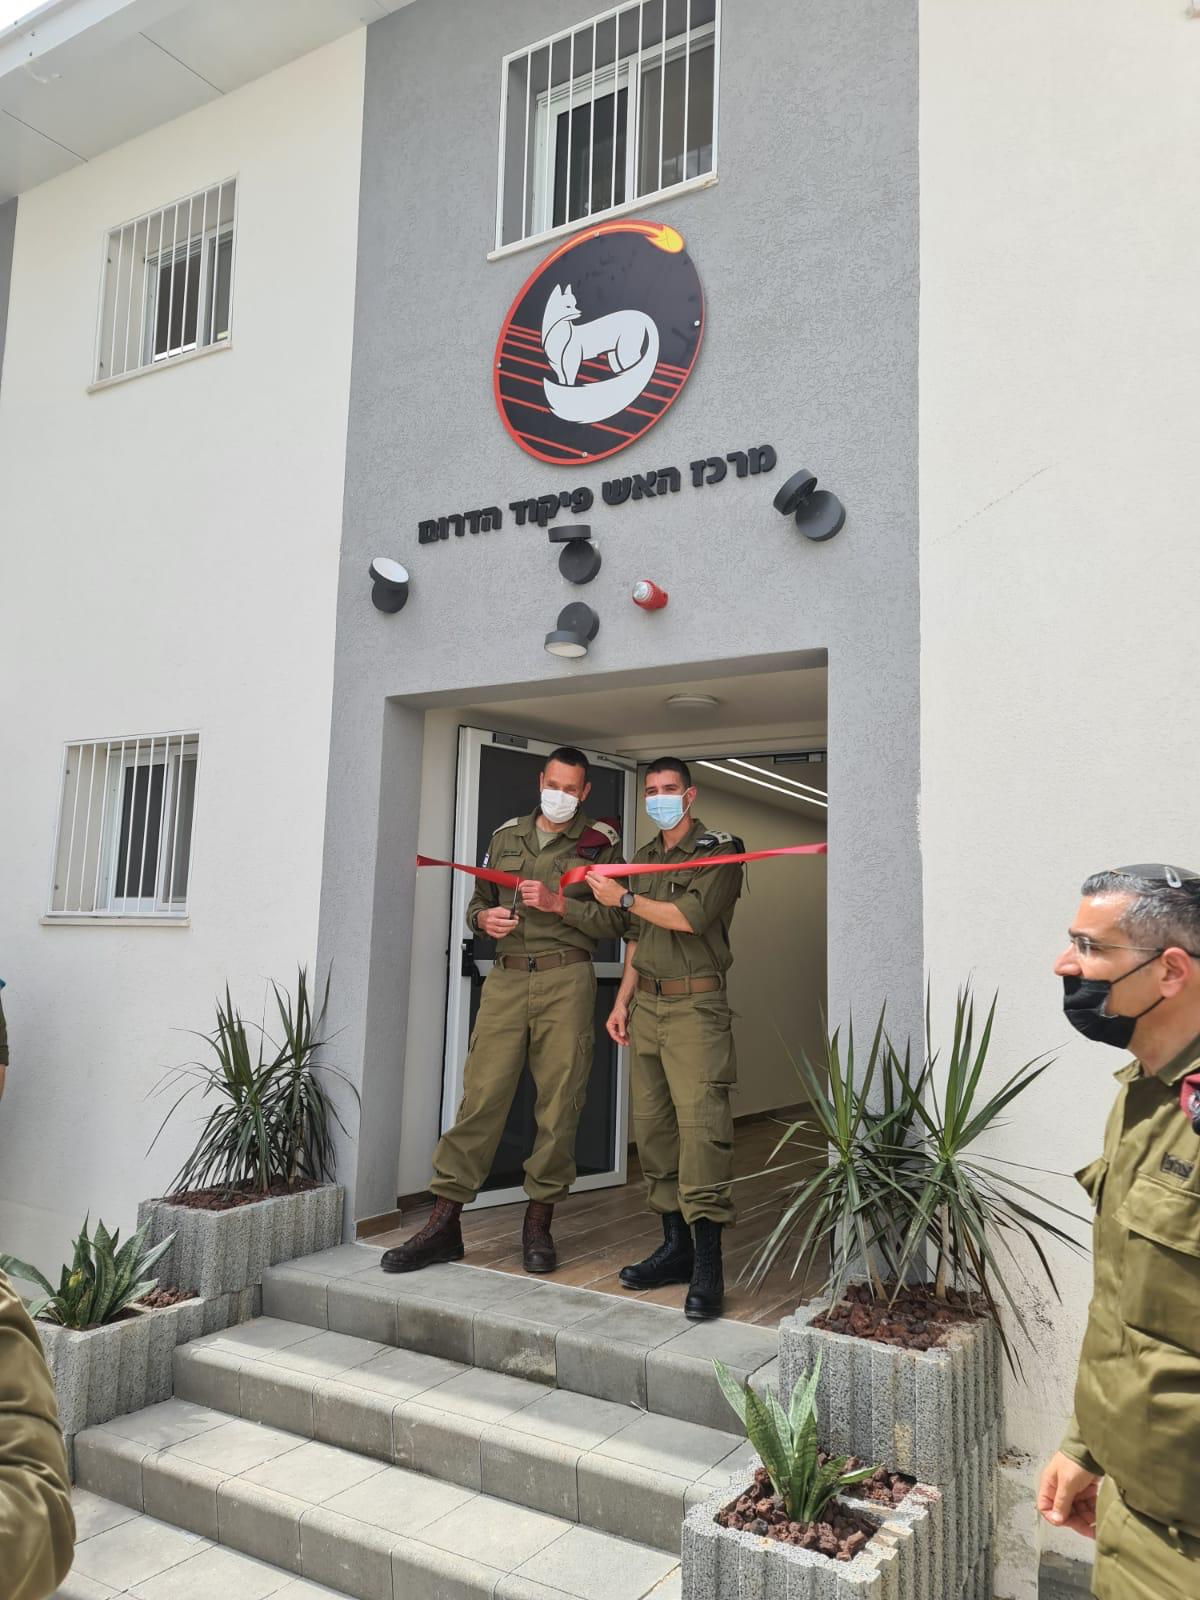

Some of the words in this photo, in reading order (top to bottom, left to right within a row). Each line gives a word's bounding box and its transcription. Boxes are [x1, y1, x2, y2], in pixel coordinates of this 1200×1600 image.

[601, 466, 681, 505] האש
[690, 444, 777, 487] מרכז
[417, 506, 503, 544] הדרום
[509, 486, 594, 527] פיקוד
